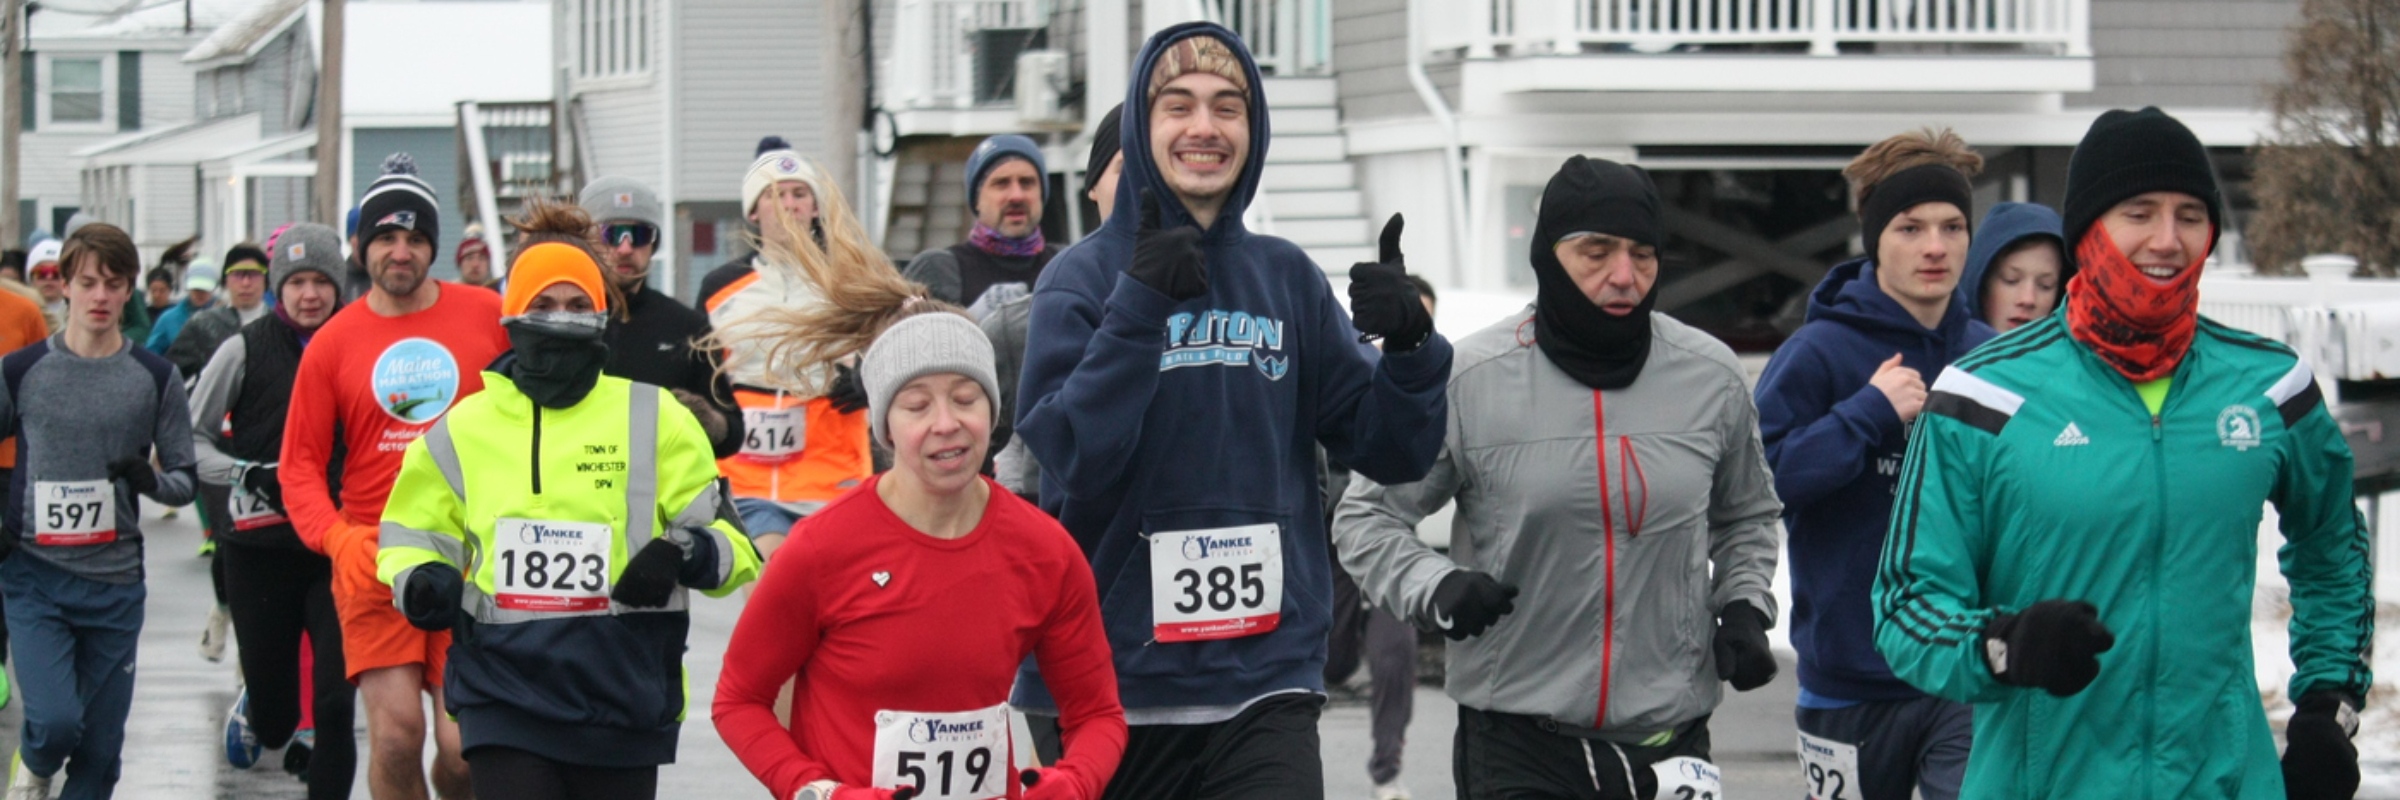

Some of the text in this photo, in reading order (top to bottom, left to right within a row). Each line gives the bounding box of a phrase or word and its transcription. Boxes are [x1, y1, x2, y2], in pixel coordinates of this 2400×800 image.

[1164, 308, 1284, 350] RITON
[384, 356, 442, 376] Maine
[380, 370, 452, 387] MARATHON
[377, 441, 408, 452] OCTO
[584, 445, 618, 454] TOWN OF
[746, 426, 794, 451] 614
[576, 461, 626, 472] WINCHESTER
[594, 479, 613, 489] DPW
[48, 501, 103, 529] 597
[533, 525, 583, 543] YANKEE
[1196, 536, 1252, 558] YANKEE
[501, 549, 604, 592] 1823
[1174, 563, 1264, 614] 385
[926, 719, 984, 742] YANKEE
[897, 747, 991, 797] 519
